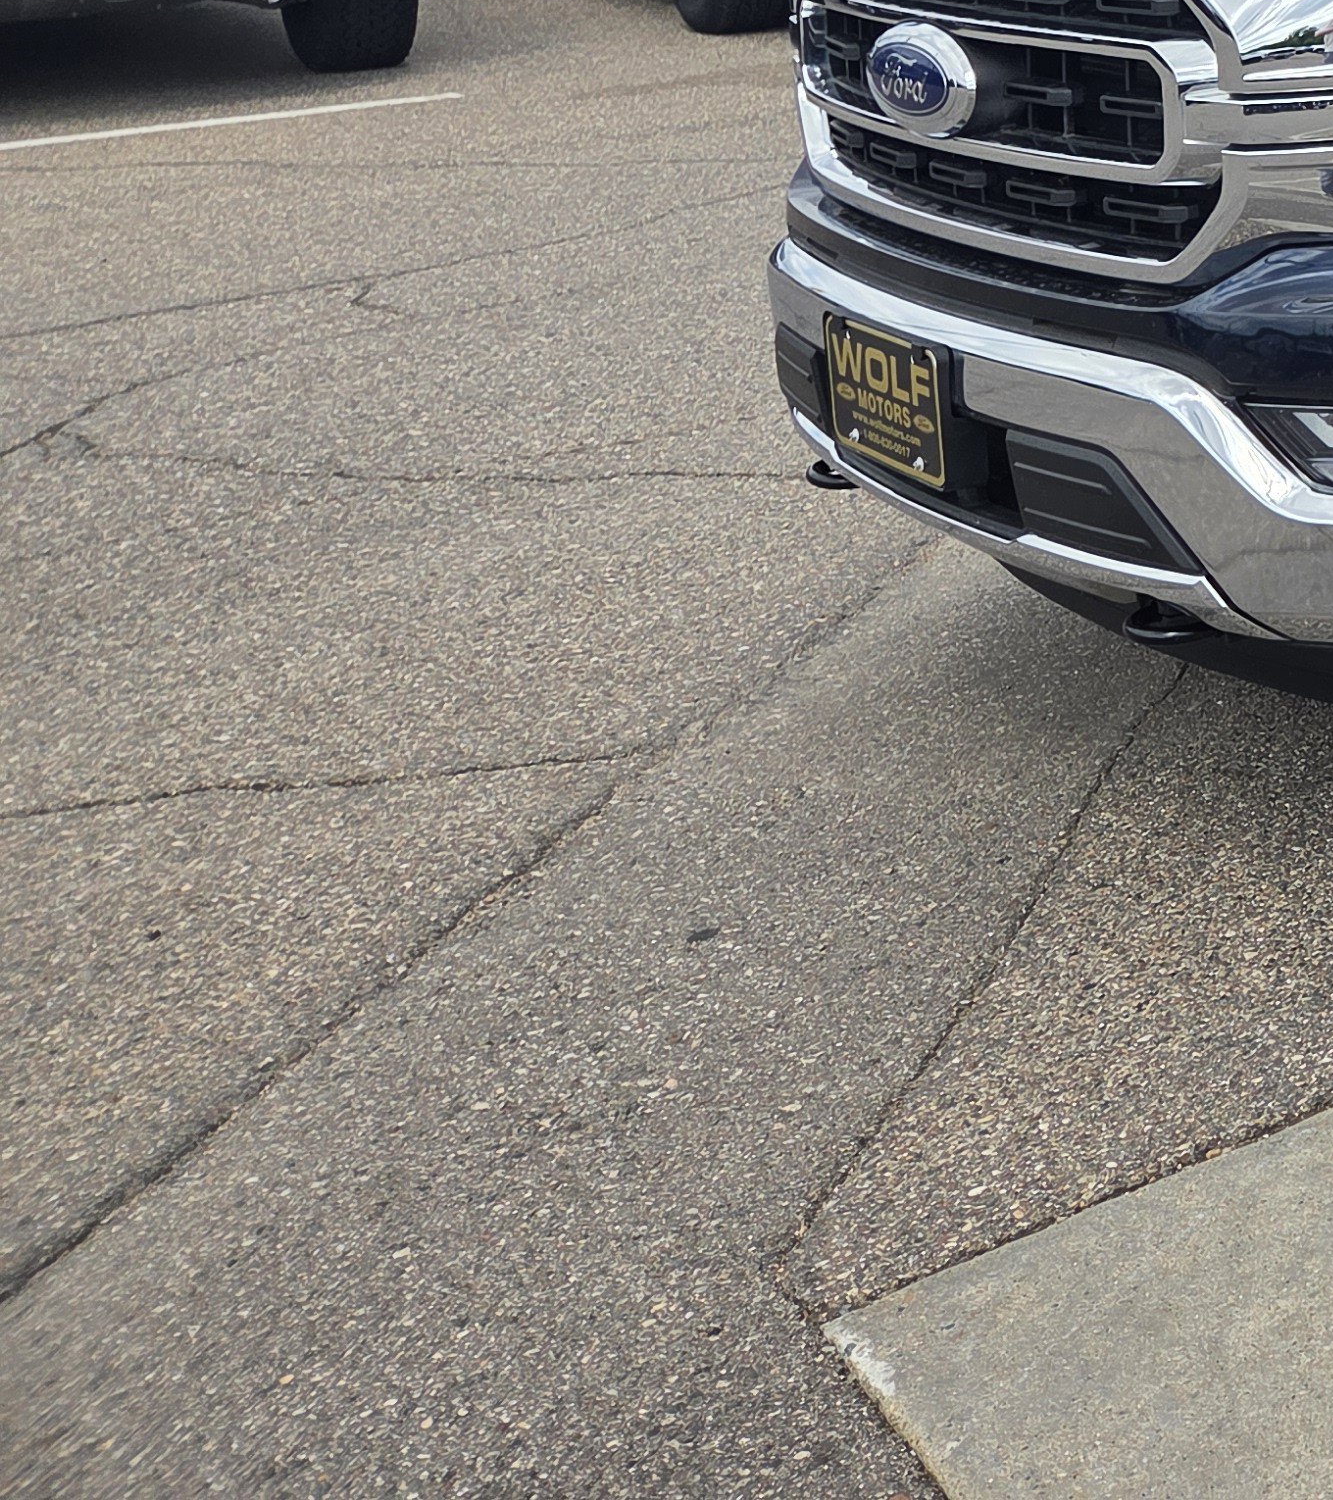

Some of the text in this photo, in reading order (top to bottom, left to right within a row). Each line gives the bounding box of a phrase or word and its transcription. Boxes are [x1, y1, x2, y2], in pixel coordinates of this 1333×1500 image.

[886, 52, 929, 104] Ford
[832, 333, 930, 406] WOLF
[857, 387, 912, 428] MOTORS
